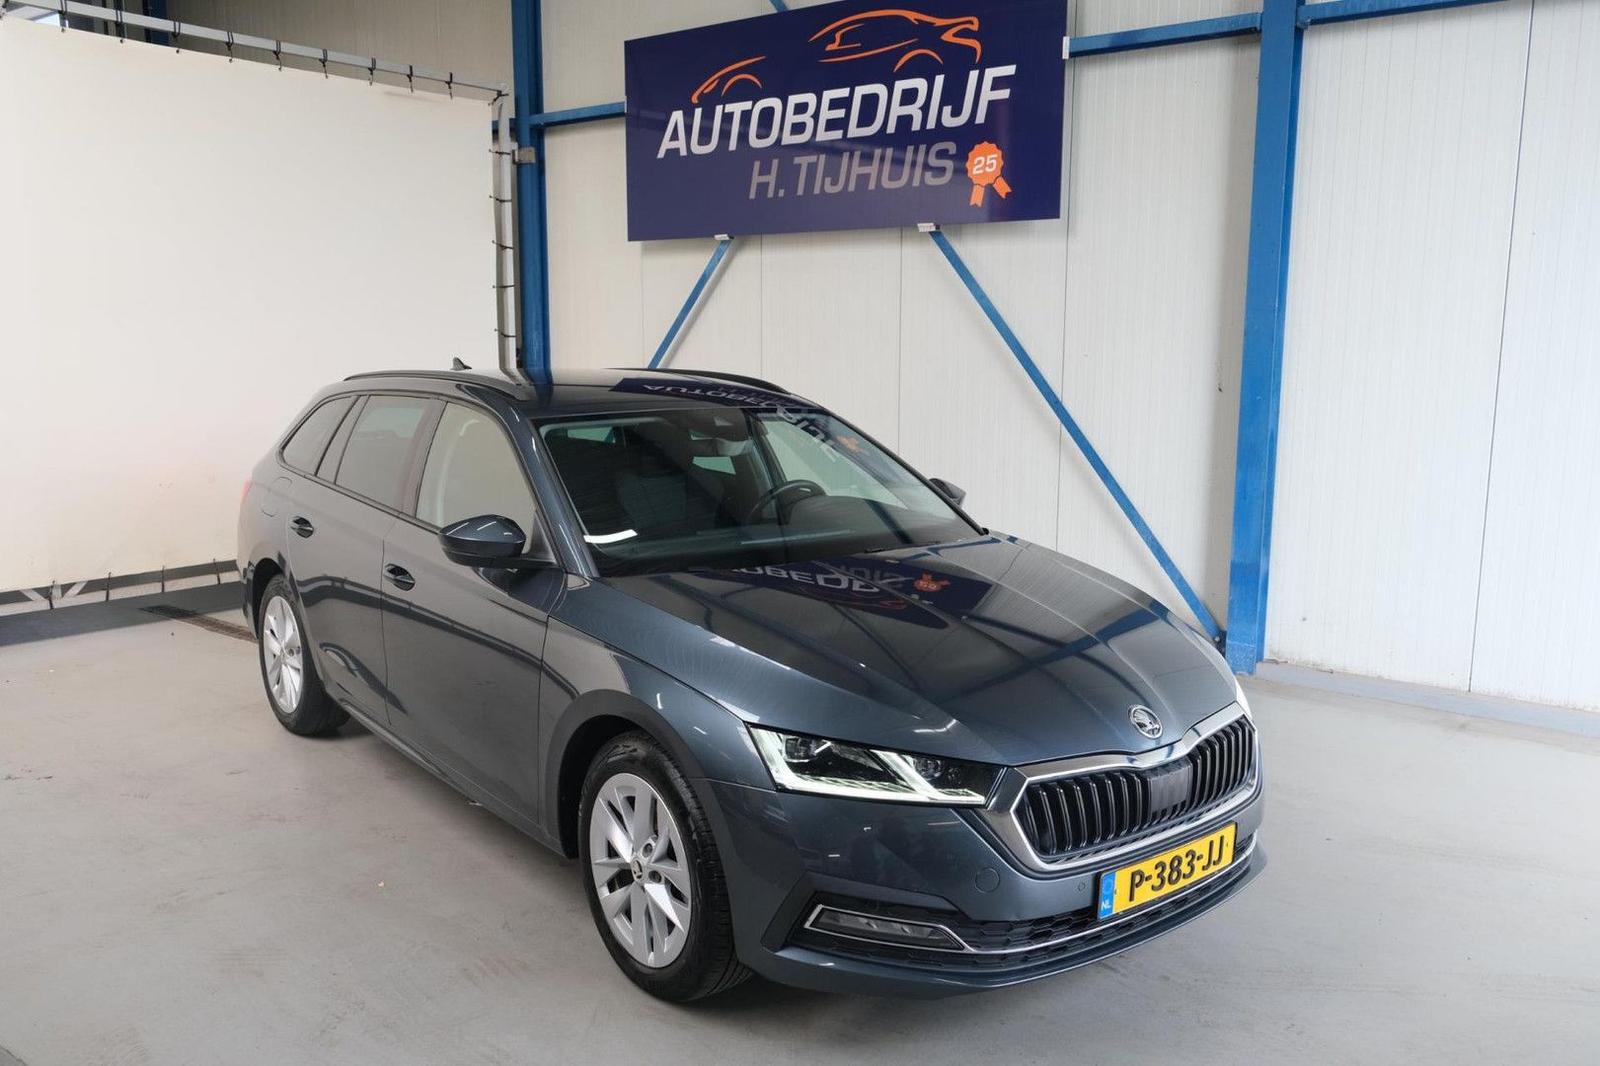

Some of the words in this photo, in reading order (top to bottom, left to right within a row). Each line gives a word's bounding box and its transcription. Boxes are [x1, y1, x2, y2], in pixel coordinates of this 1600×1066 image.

[657, 64, 1017, 159] AUTOBEDRIJF
[748, 157, 785, 199] H.
[795, 141, 957, 197] TIJHUIS
[972, 154, 998, 175] 25
[1129, 835, 1224, 902] P-383-JJ
[1100, 900, 1112, 910] NL
